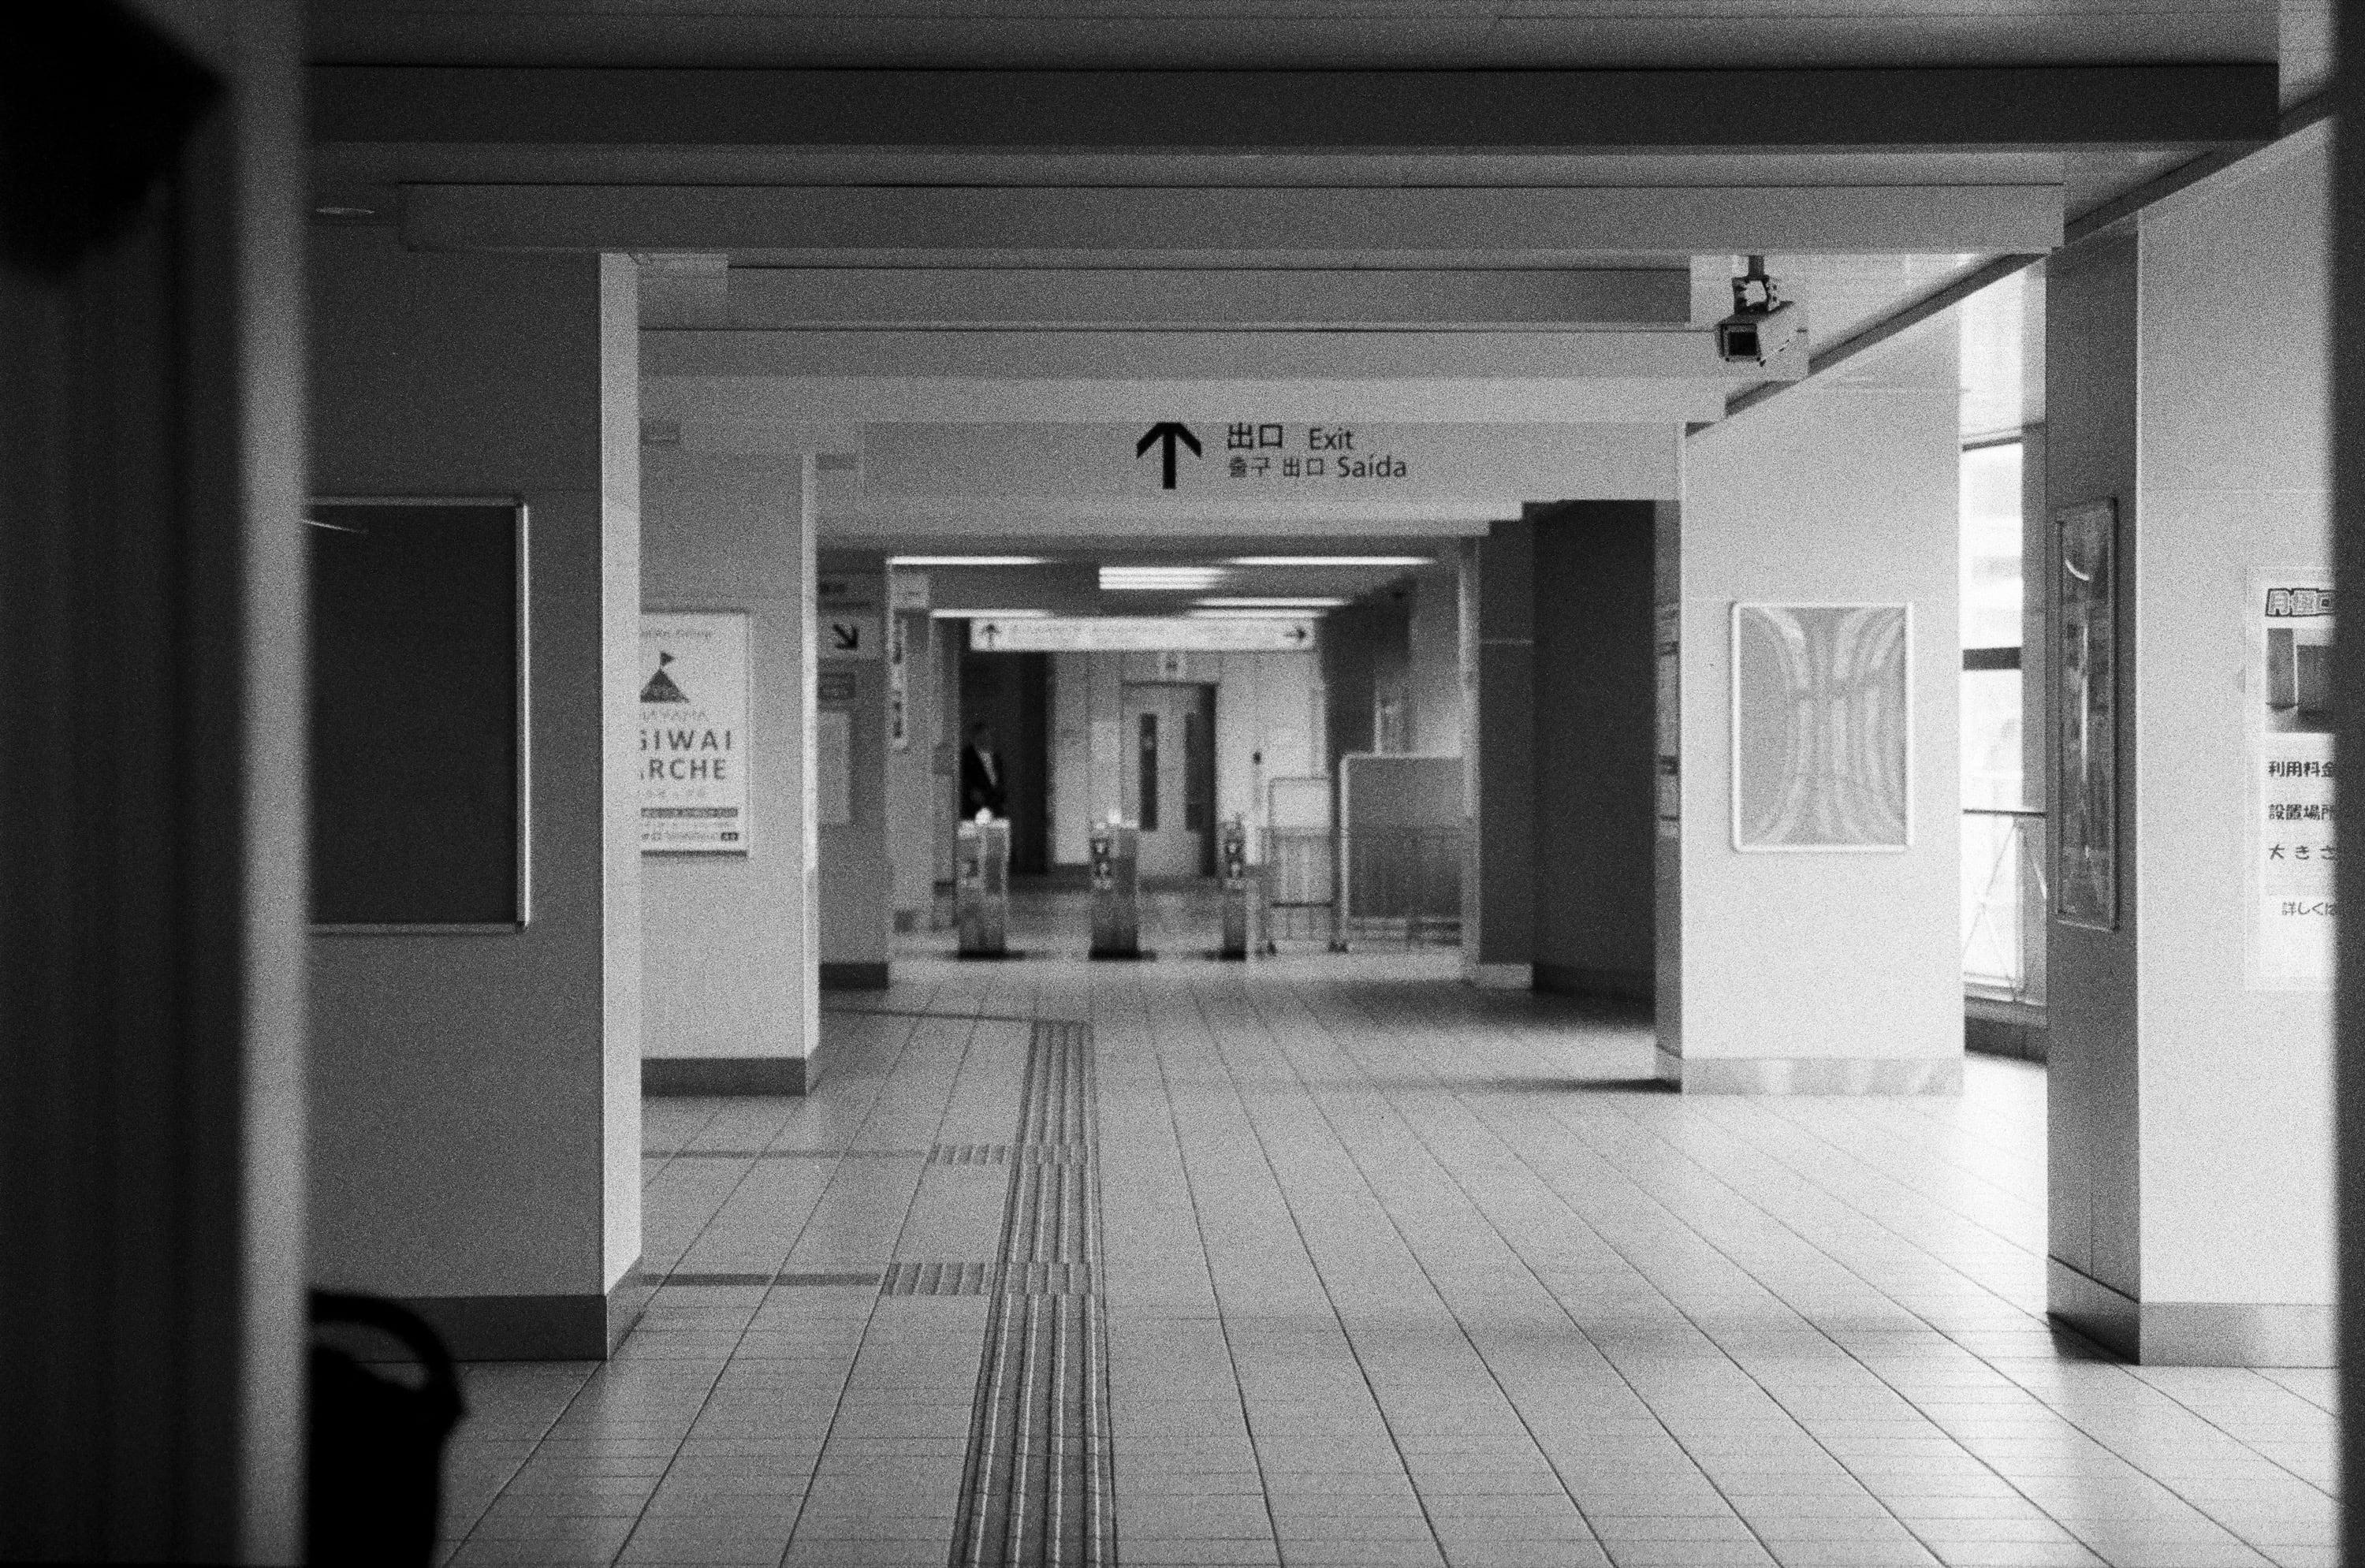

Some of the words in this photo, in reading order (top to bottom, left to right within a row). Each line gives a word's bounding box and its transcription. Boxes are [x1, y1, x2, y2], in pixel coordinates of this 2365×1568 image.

[1227, 423, 1283, 450] 出口
[1309, 427, 1354, 450] Exit
[1283, 457, 1324, 478] 出口
[2268, 761, 2336, 777] 利用料金
